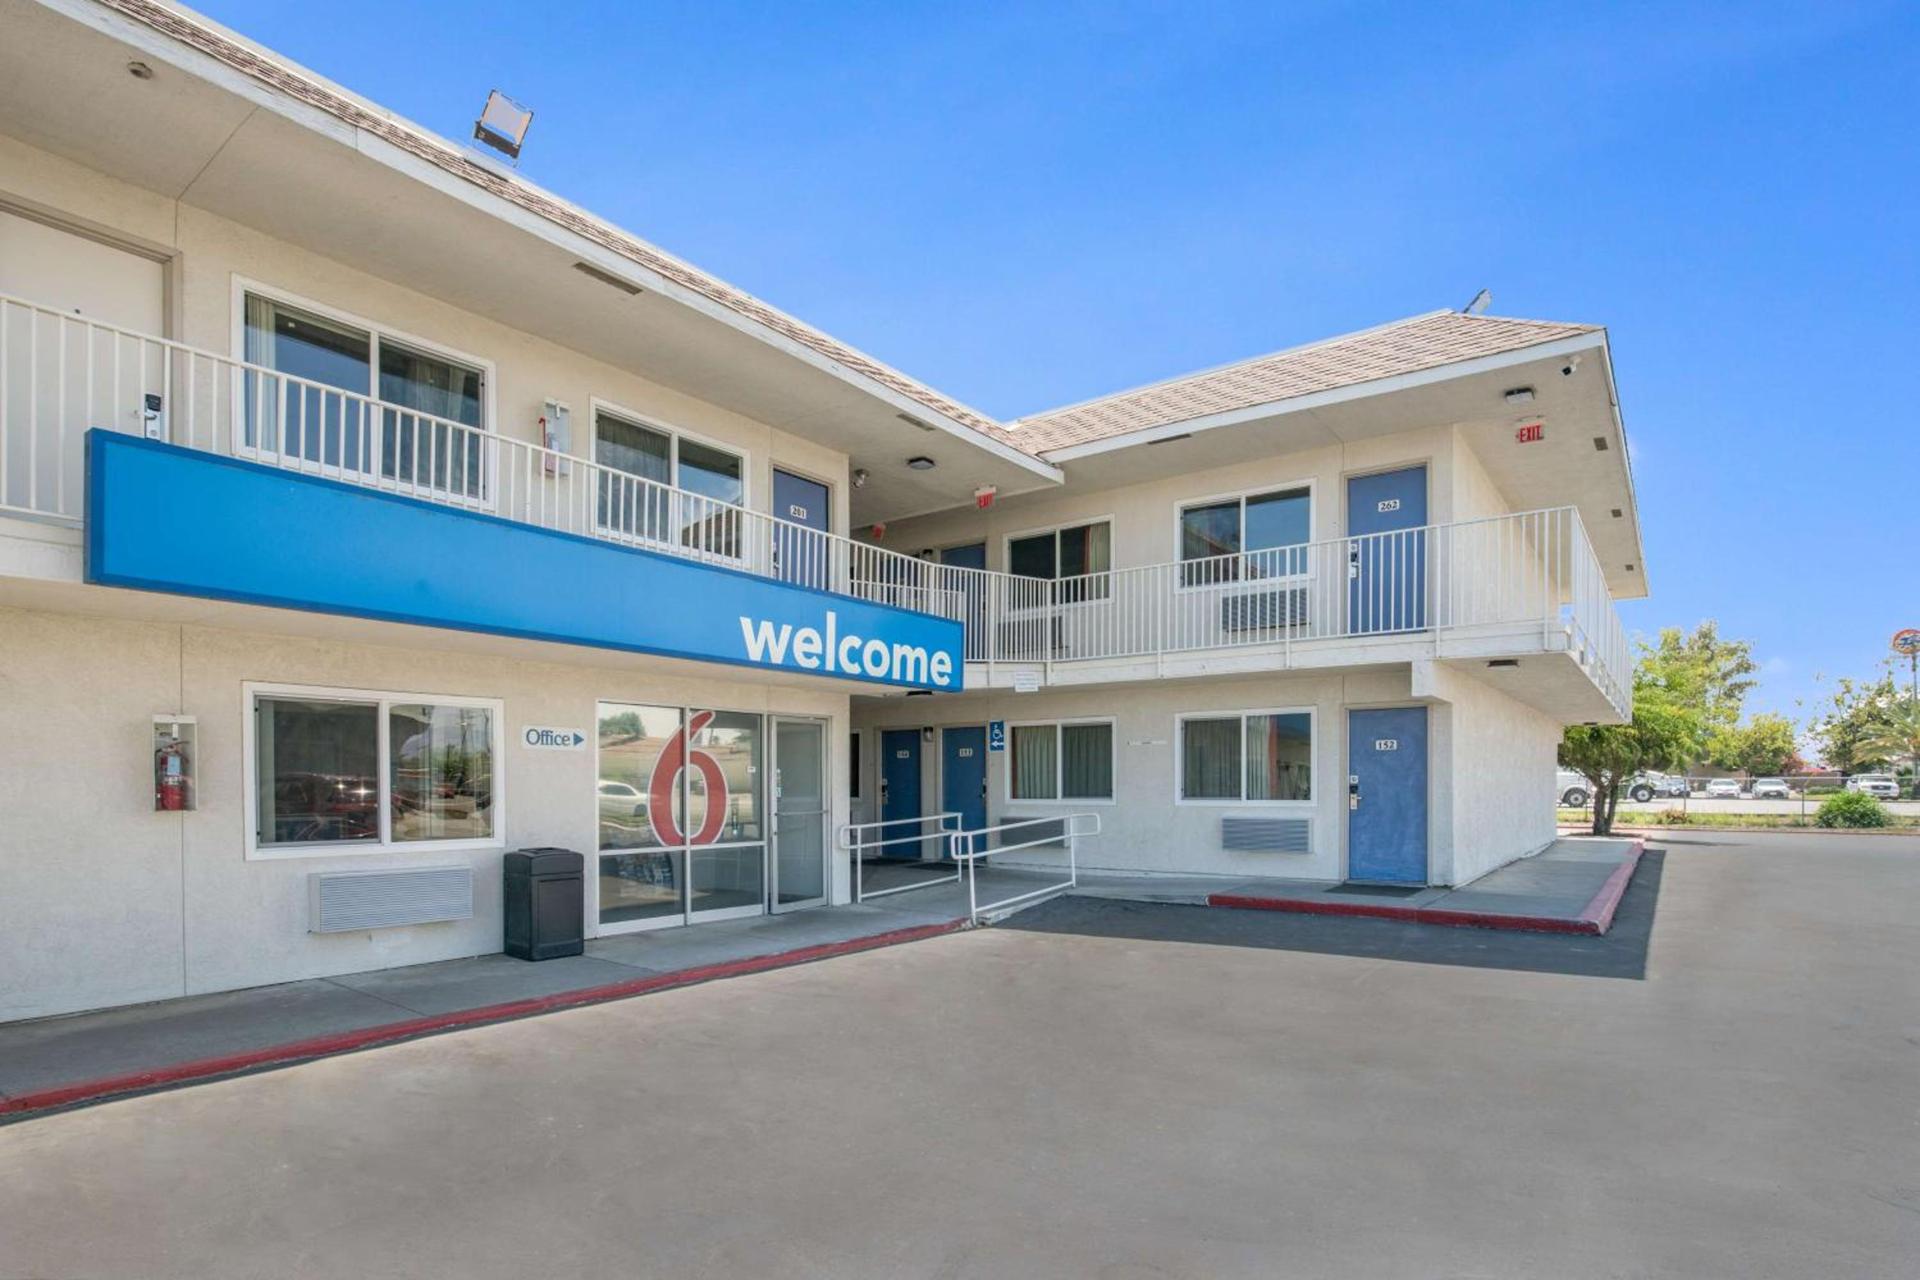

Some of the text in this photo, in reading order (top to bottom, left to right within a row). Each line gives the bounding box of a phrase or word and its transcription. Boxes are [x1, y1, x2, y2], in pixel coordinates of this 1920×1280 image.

[1519, 424, 1542, 443] EXIT
[1379, 501, 1398, 511] 262
[739, 611, 953, 687] welcome
[526, 728, 571, 746] Office
[1378, 740, 1395, 750] 152
[648, 710, 730, 847] 6
